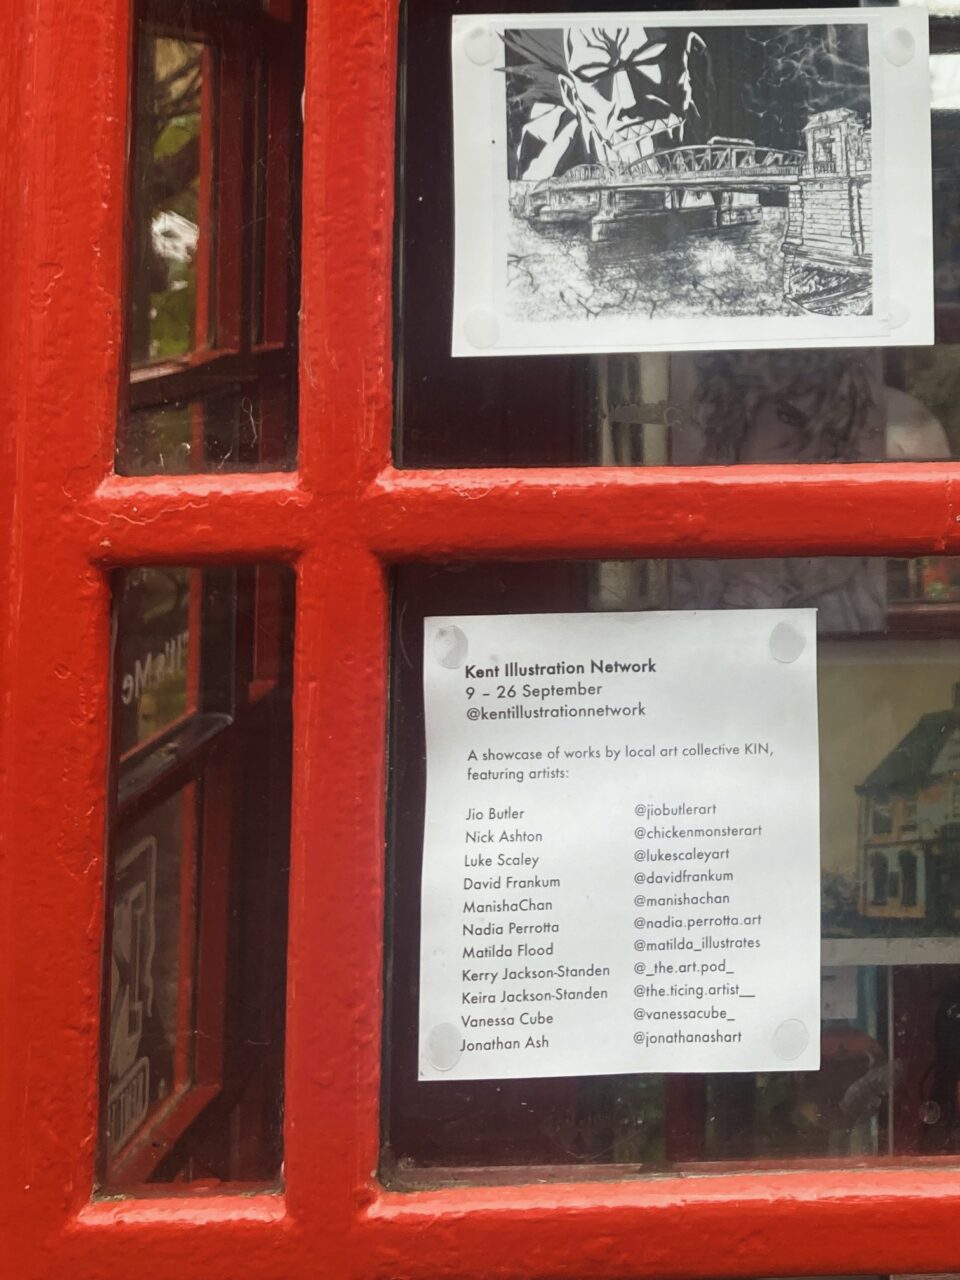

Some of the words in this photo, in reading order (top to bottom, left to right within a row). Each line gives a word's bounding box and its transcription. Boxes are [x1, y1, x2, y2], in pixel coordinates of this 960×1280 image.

[465, 665, 500, 678] Kent
[505, 662, 585, 677] Illustration
[590, 659, 656, 673] Network
[466, 686, 475, 700] 9
[497, 685, 517, 698] 26
[522, 681, 602, 700] September
[467, 703, 646, 721] @kentillustrationnetwork
[467, 750, 478, 761] A
[482, 747, 543, 761] showcase
[547, 746, 561, 759] of
[564, 746, 601, 759] works
[606, 745, 621, 761] by
[625, 744, 655, 758] local
[660, 745, 677, 757] art
[682, 743, 739, 757] collective
[744, 742, 774, 758] KIN,
[467, 768, 524, 783] featuring
[528, 767, 569, 779] artists:
[466, 808, 484, 821] Jio
[488, 807, 525, 820] Butler
[634, 802, 716, 818] @jiobutlerart
[465, 831, 494, 843] Nick
[498, 830, 543, 843] Ashton
[634, 825, 762, 840] @chickenmonsterart
[464, 854, 493, 867] Luke
[497, 854, 539, 869] Scaley
[634, 848, 729, 863] @lukescaleyart
[463, 877, 501, 890] David
[506, 876, 560, 888] Frankum
[634, 870, 734, 885] @davidfrankum
[463, 899, 553, 913] ManishaChan
[634, 893, 730, 907] @manishachan
[463, 922, 505, 936] Nadia
[509, 921, 559, 934] Perrotta
[634, 915, 761, 930] @nadia.perrotta.art
[463, 945, 513, 959] Matilda
[518, 943, 553, 956] Flood
[634, 937, 760, 953] @matilda_illustrates
[462, 969, 498, 984] Kerry
[502, 964, 610, 980] Jackson-Standen
[462, 991, 496, 1004] Keira
[500, 987, 608, 1002] Jackson-Standen
[461, 1015, 515, 1027] Vanessa
[519, 1011, 553, 1026] Cube
[634, 1006, 735, 1022] @vanessacube_
[460, 1037, 520, 1052] Jonathan
[525, 1035, 549, 1049] Ash
[634, 1029, 742, 1047] @jonathanashart
